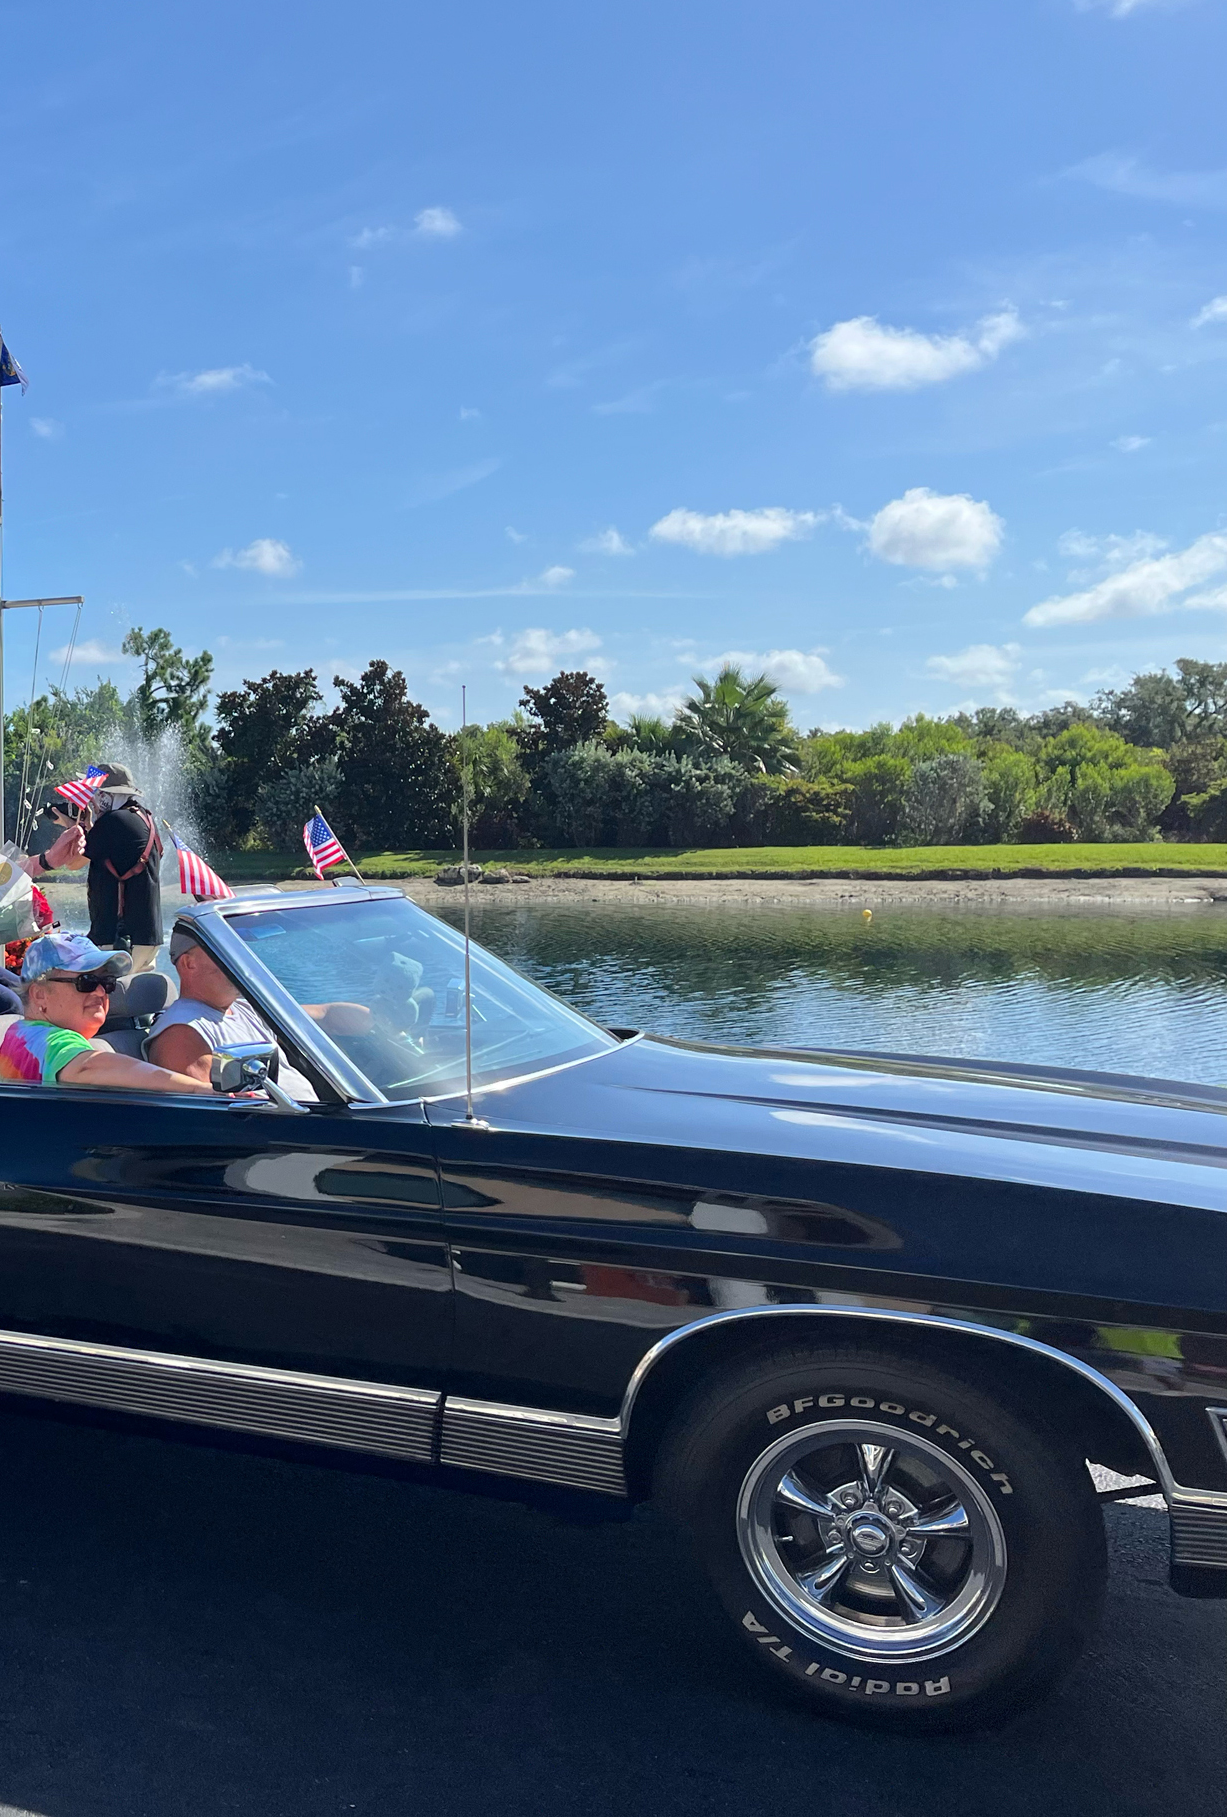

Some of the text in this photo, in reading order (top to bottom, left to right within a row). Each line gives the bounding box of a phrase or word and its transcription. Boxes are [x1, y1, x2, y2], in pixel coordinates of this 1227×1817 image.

[766, 1393, 1014, 1495] BFGoodrich
[741, 1610, 952, 1697] Radial T/A
